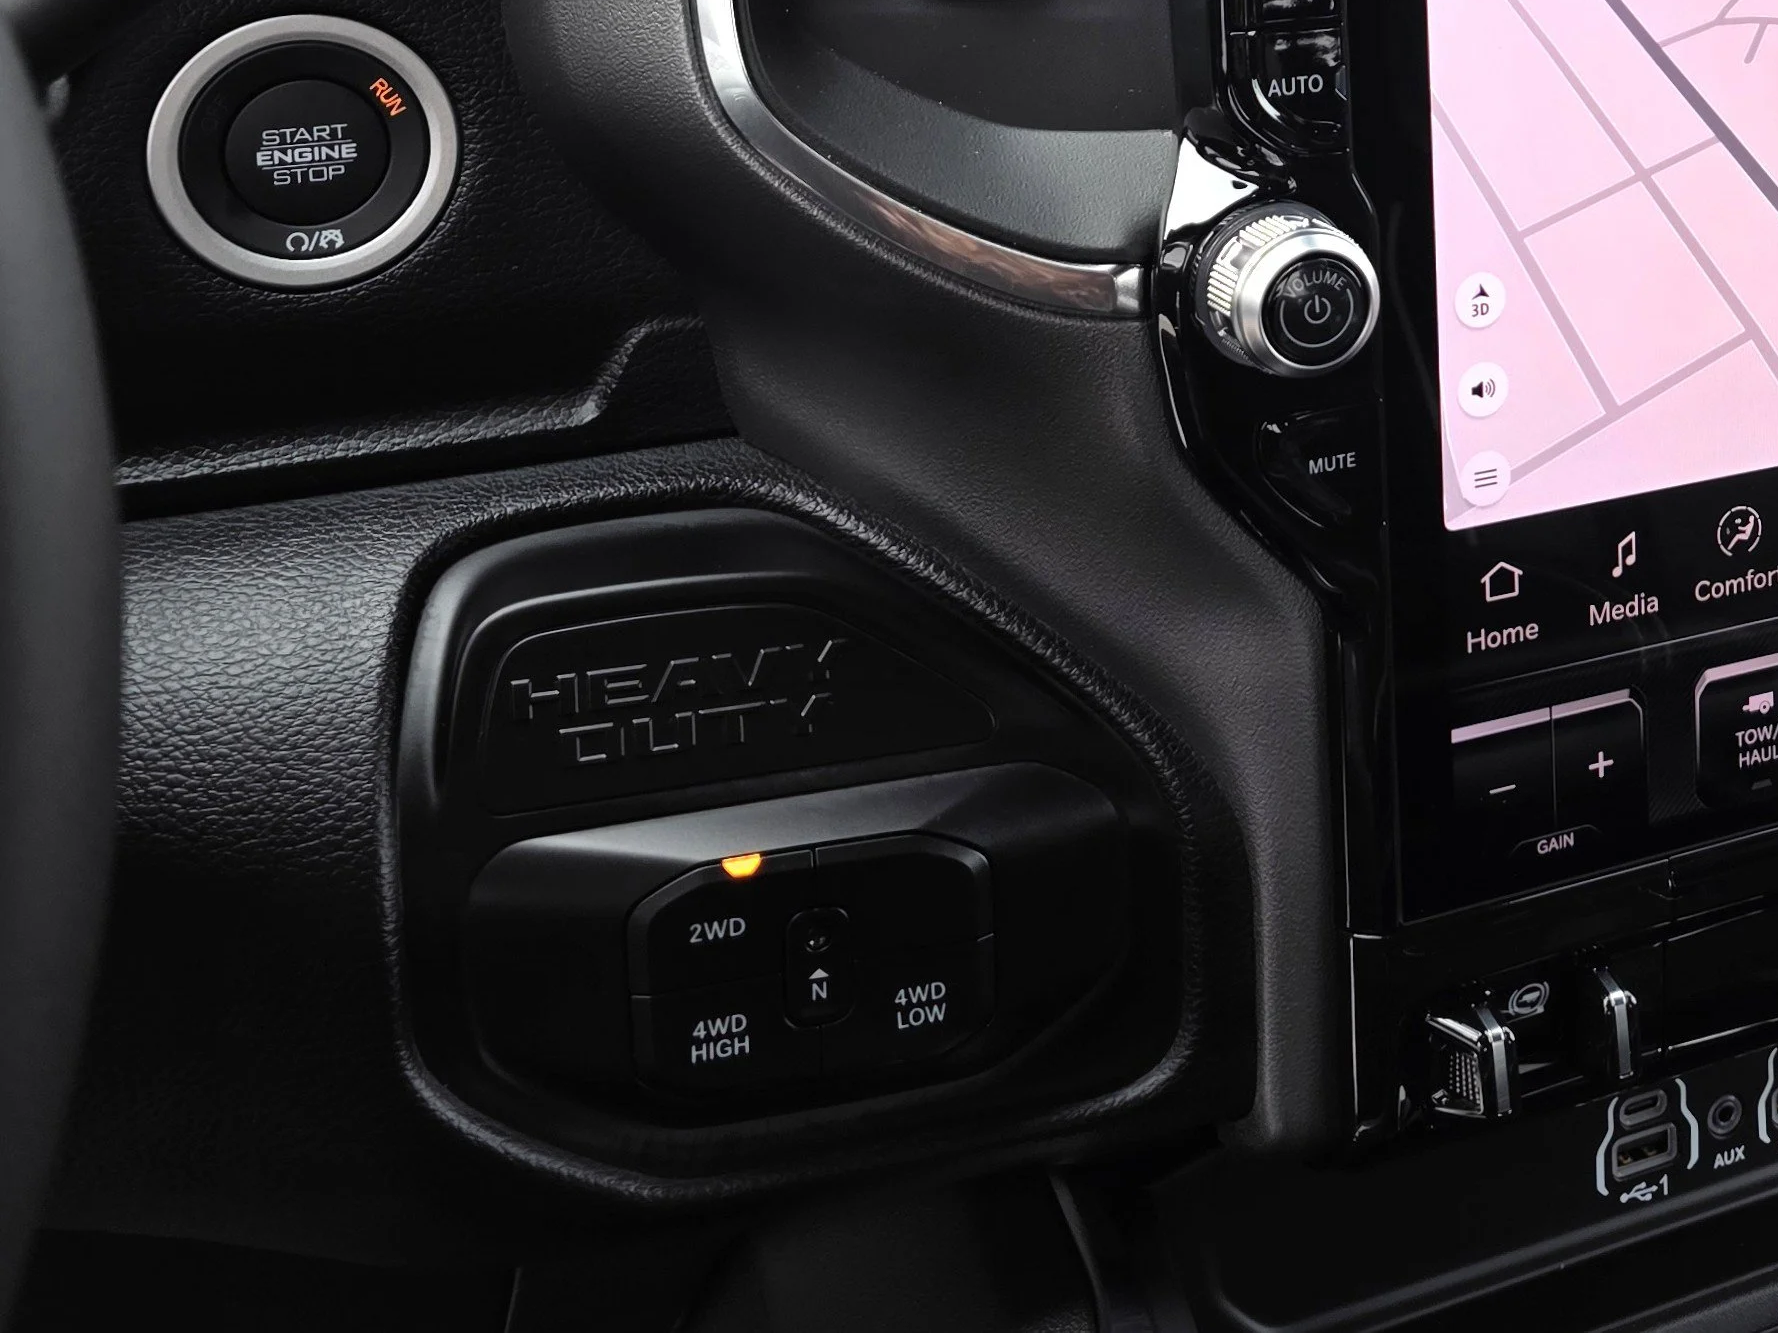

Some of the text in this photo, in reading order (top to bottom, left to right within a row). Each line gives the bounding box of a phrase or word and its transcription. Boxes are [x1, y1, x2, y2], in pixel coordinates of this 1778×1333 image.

[370, 78, 406, 116] RUN
[1268, 73, 1324, 98] AUTO
[262, 123, 347, 145] START
[256, 143, 357, 166] ENGINE
[274, 166, 345, 185] STOP
[1283, 271, 1347, 299] VOLUME
[1471, 302, 1489, 317] 3D
[1309, 452, 1356, 474] MUTE
[1589, 592, 1659, 626] Media
[1466, 618, 1540, 654] Home
[1536, 833, 1575, 855] GAIN
[689, 917, 747, 944] 2WD
[811, 980, 828, 1001] N
[894, 981, 947, 1006] 4WD
[691, 1014, 748, 1040] 4WD
[896, 1003, 947, 1030] LOW
[690, 1034, 750, 1065] HIGH
[1713, 1145, 1745, 1169] AUX
[1660, 1174, 1669, 1196] 1
